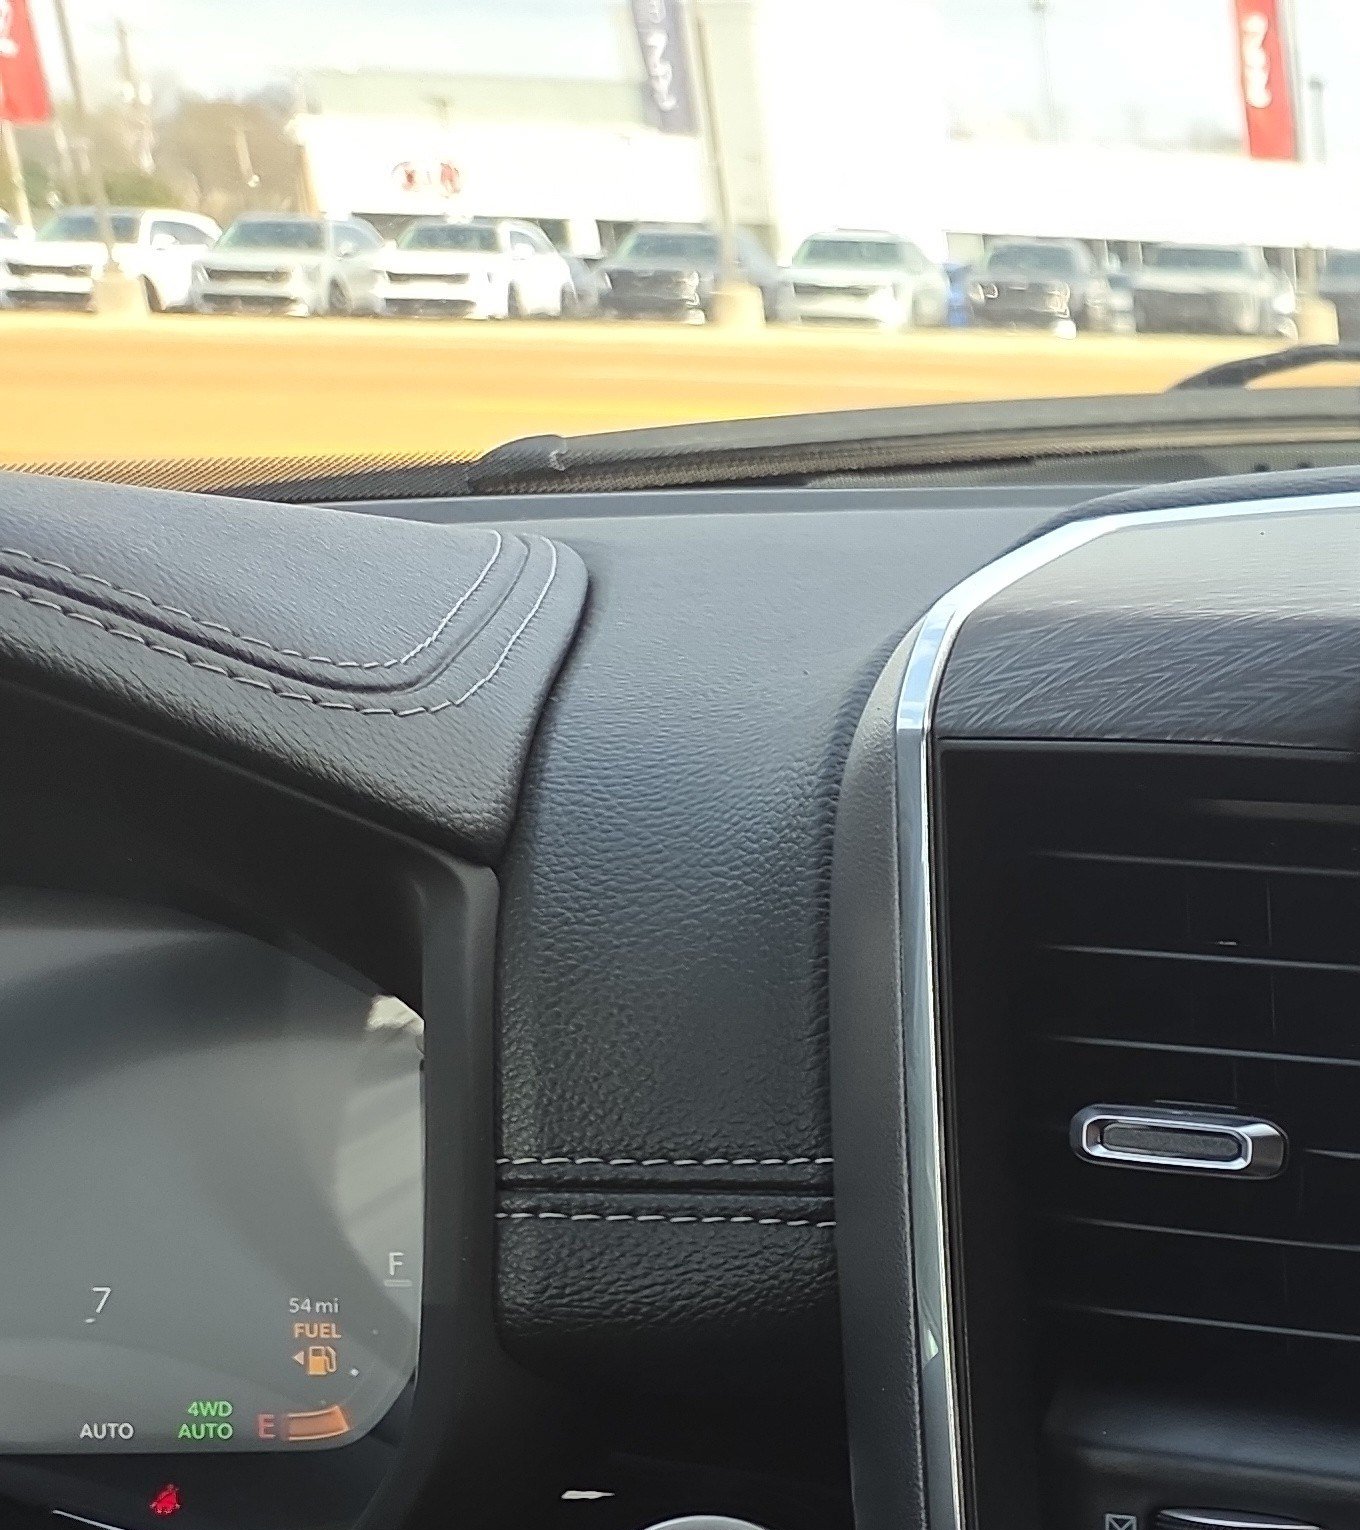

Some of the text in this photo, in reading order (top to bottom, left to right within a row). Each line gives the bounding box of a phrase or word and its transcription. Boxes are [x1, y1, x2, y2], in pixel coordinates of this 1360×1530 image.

[289, 1297, 340, 1314] 54 mi
[294, 1323, 341, 1339] FUEL
[188, 1401, 233, 1417] 4WD
[80, 1423, 134, 1440] AUTO
[178, 1423, 233, 1440] AUTO
